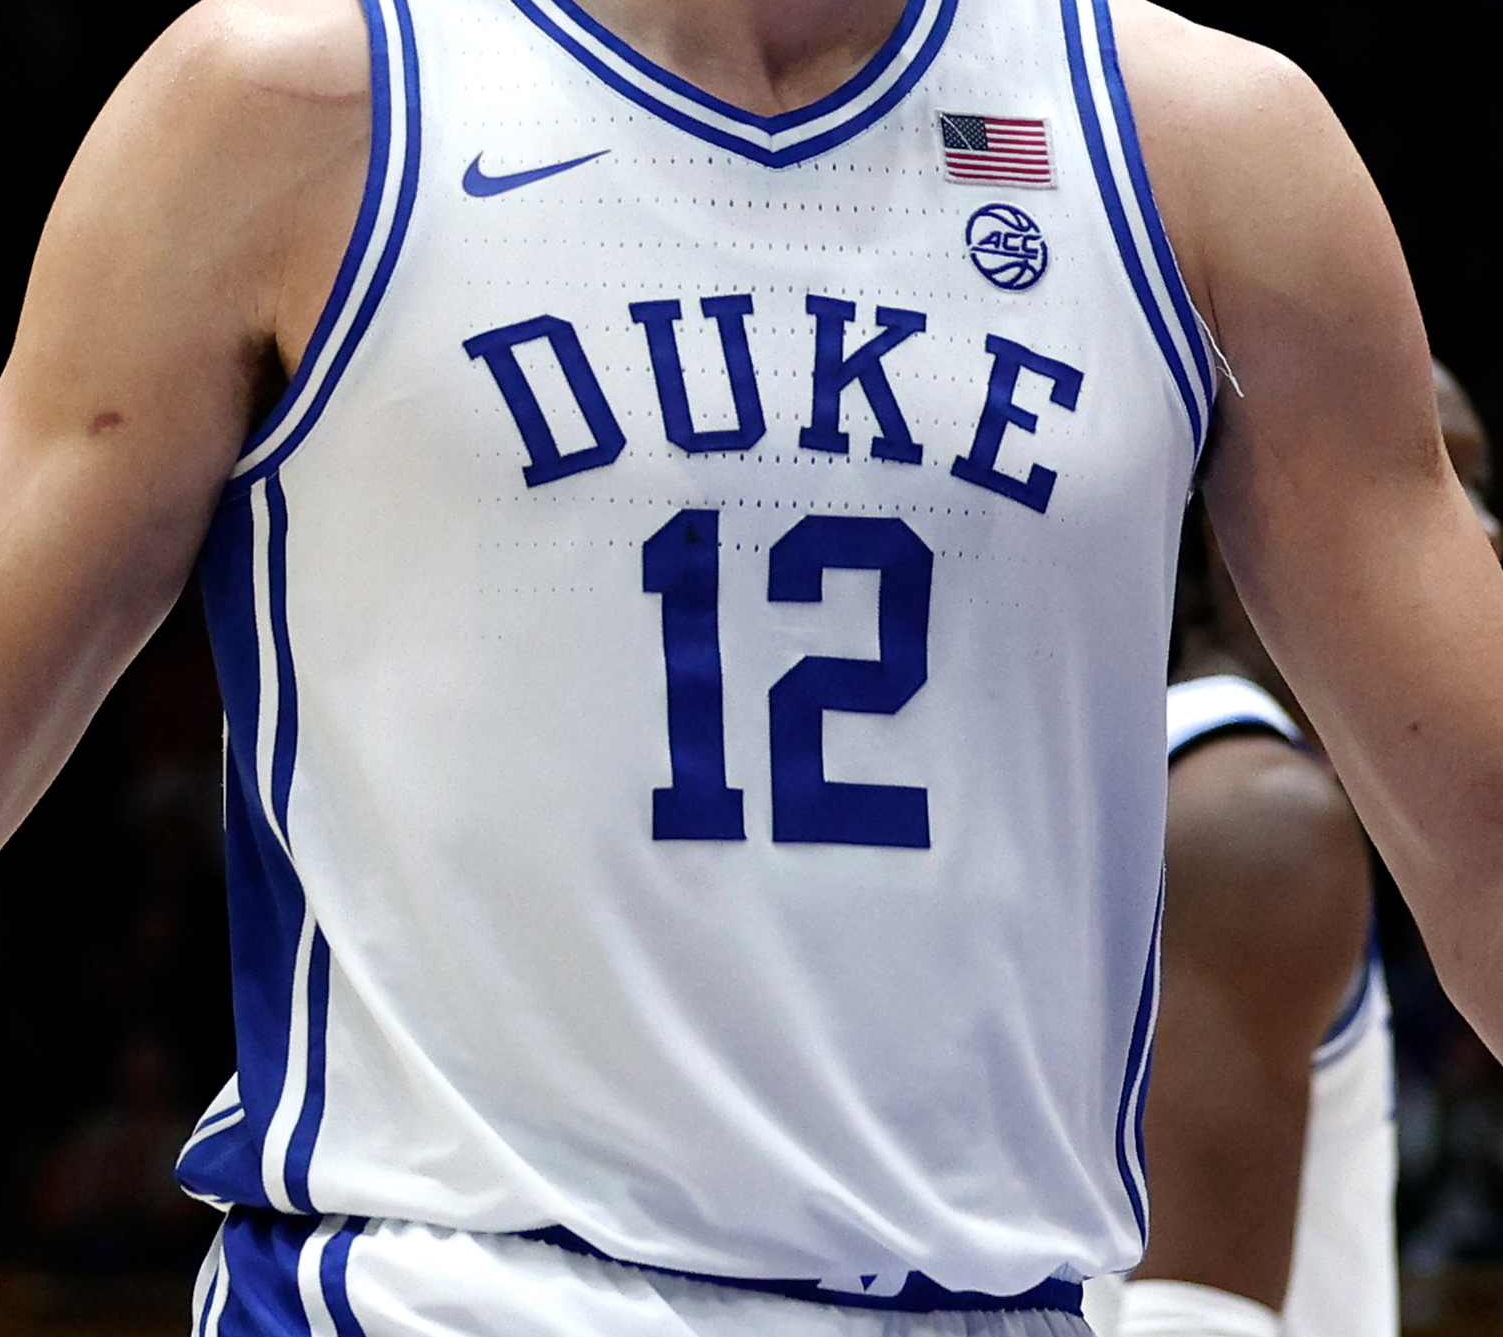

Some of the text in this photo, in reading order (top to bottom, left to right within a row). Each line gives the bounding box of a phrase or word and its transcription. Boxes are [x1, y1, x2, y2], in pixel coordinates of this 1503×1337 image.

[977, 230, 1044, 256] ACC
[462, 293, 1085, 514] DUKE
[641, 508, 934, 849] 12
